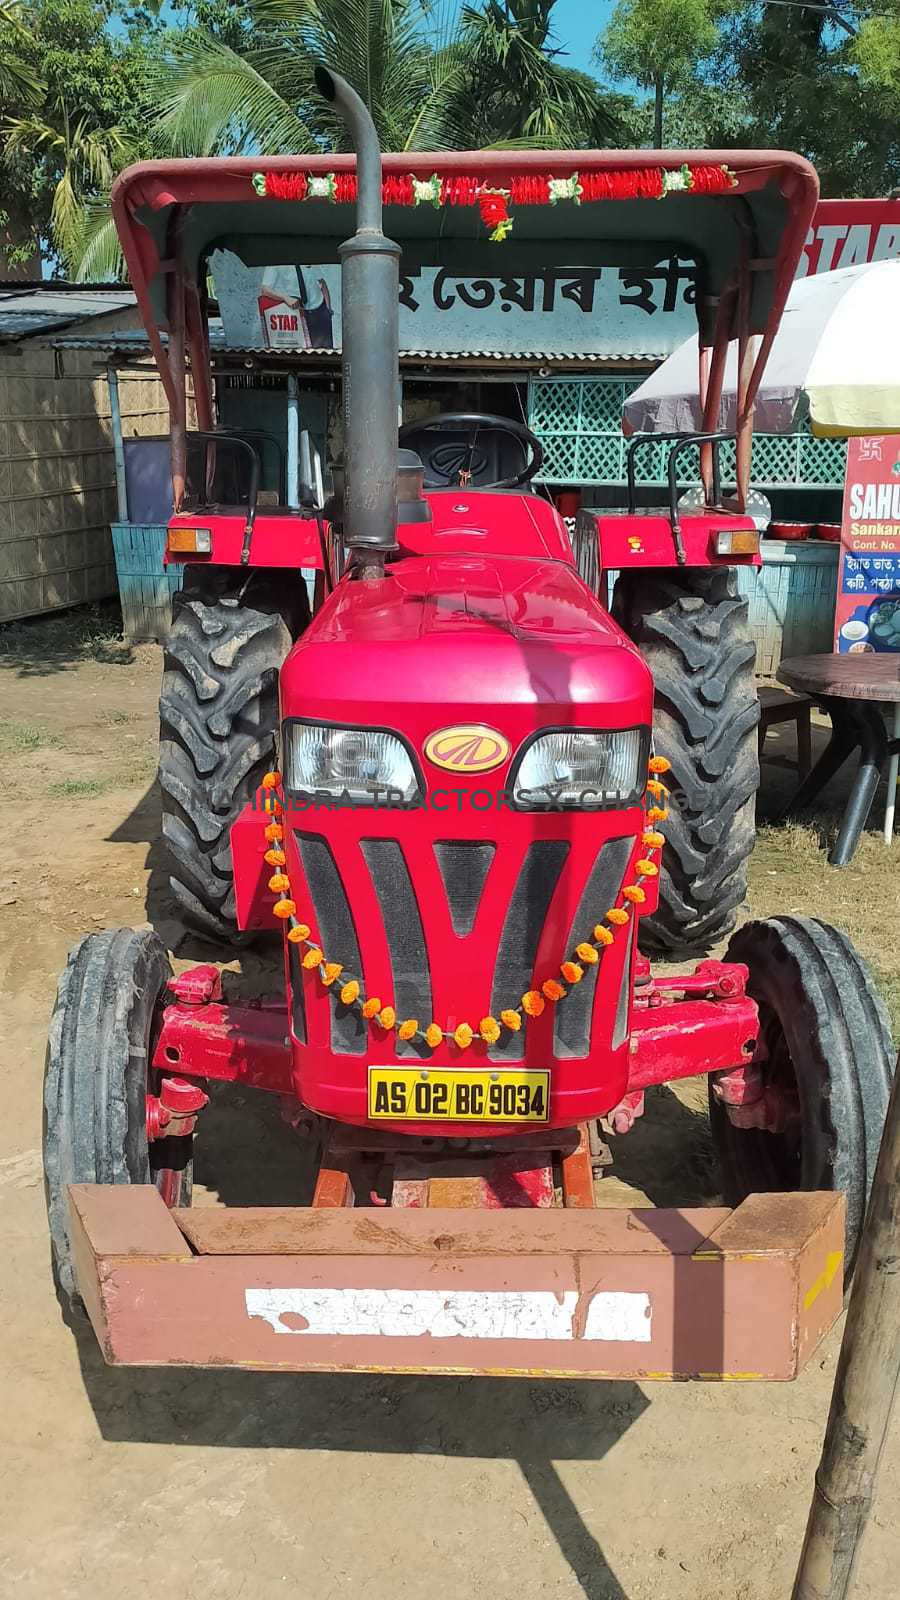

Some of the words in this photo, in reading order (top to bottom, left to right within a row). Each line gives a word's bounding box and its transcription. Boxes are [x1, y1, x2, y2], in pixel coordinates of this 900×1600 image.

[269, 314, 299, 331] STAR
[375, 1081, 406, 1113] AS
[415, 1082, 448, 1114] 02
[456, 1084, 484, 1115] BC
[489, 1084, 545, 1116] 9034
